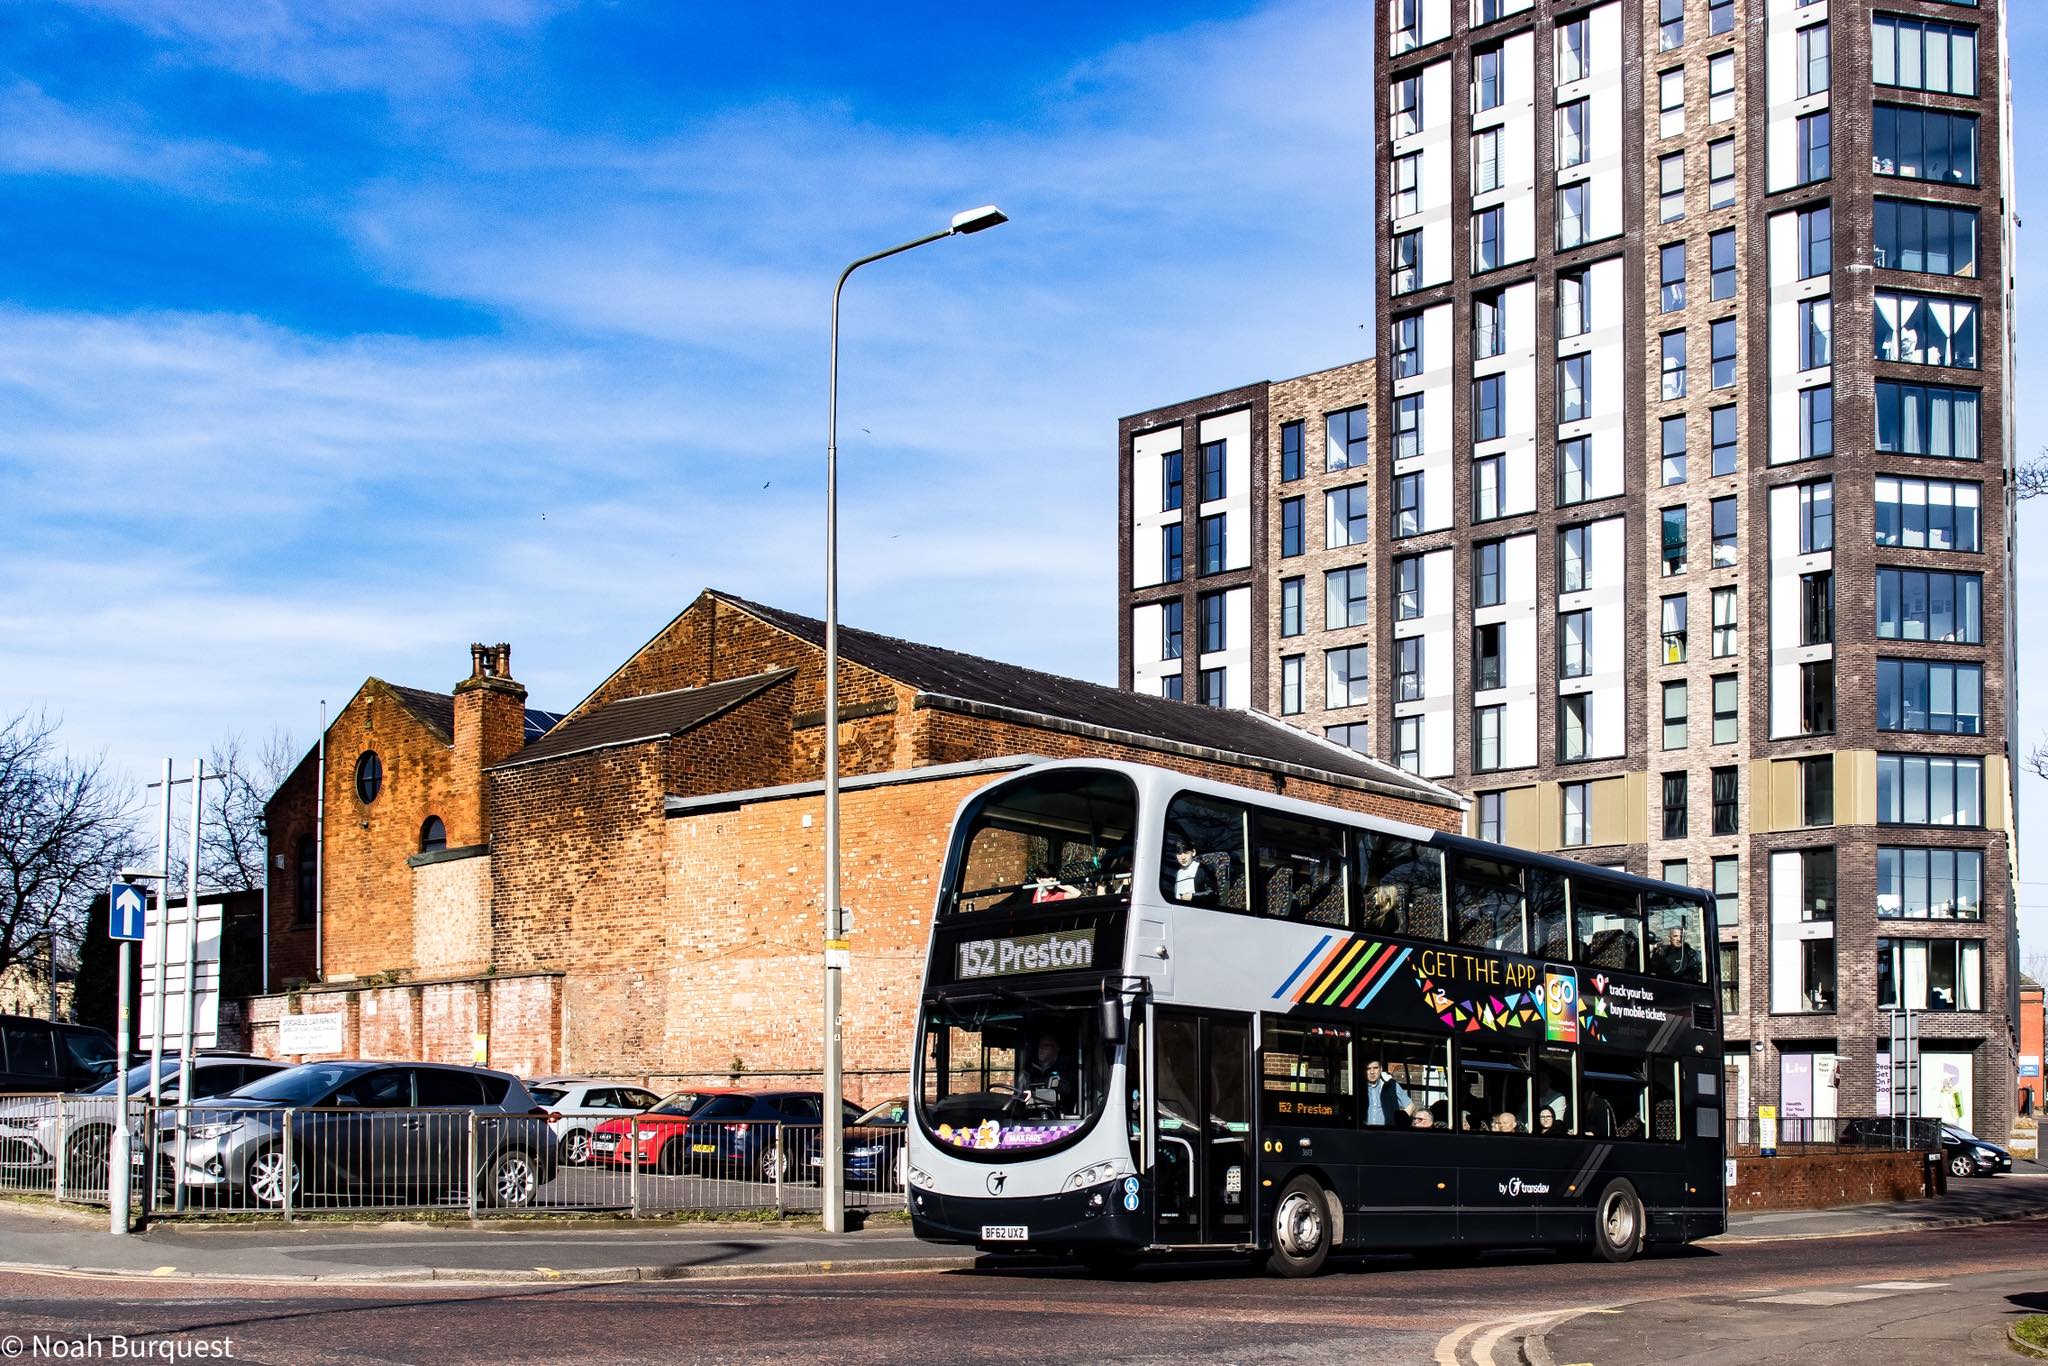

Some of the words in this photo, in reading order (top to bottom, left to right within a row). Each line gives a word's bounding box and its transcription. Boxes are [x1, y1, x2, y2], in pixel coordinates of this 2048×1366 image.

[959, 939, 996, 977] 152
[999, 936, 1093, 972] Preston
[1421, 950, 1458, 979] GET
[1463, 956, 1500, 985] THE
[1505, 962, 1536, 989] APP
[1549, 979, 1574, 1015] go
[1609, 984, 1627, 997] track
[1626, 988, 1642, 1000] your
[1641, 987, 1654, 1000] bus
[1609, 1002, 1623, 1018] buy
[1623, 1005, 1645, 1019] mobile
[1645, 1008, 1667, 1021] tickets
[1279, 1101, 1292, 1113] 152
[1297, 1103, 1333, 1116] Preston
[1009, 1133, 1026, 1143] MAX
[1026, 1132, 1043, 1143] FARE
[1498, 1182, 1508, 1195] by
[1521, 1182, 1550, 1194] transdev
[985, 1228, 1006, 1239] BF62
[1007, 1228, 1025, 1239] UXZ
